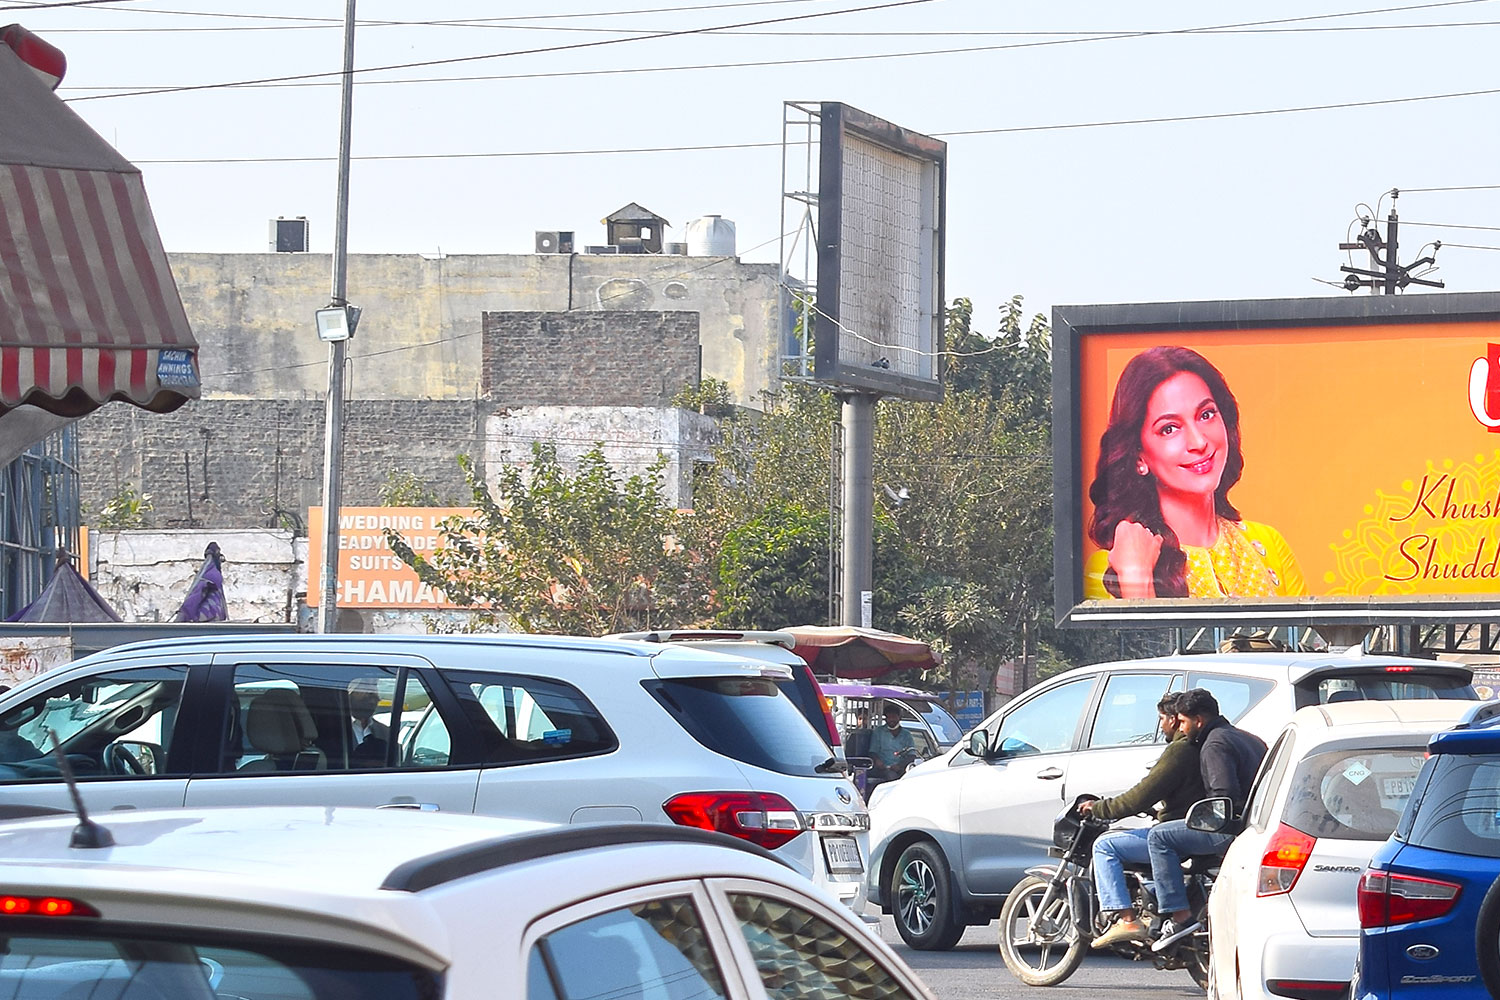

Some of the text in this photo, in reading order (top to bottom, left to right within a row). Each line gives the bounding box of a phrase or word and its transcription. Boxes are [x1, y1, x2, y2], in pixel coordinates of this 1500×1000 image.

[339, 515, 424, 530] WEDDING
[349, 555, 403, 571] SUITS
[1313, 864, 1361, 872] SANTRO
